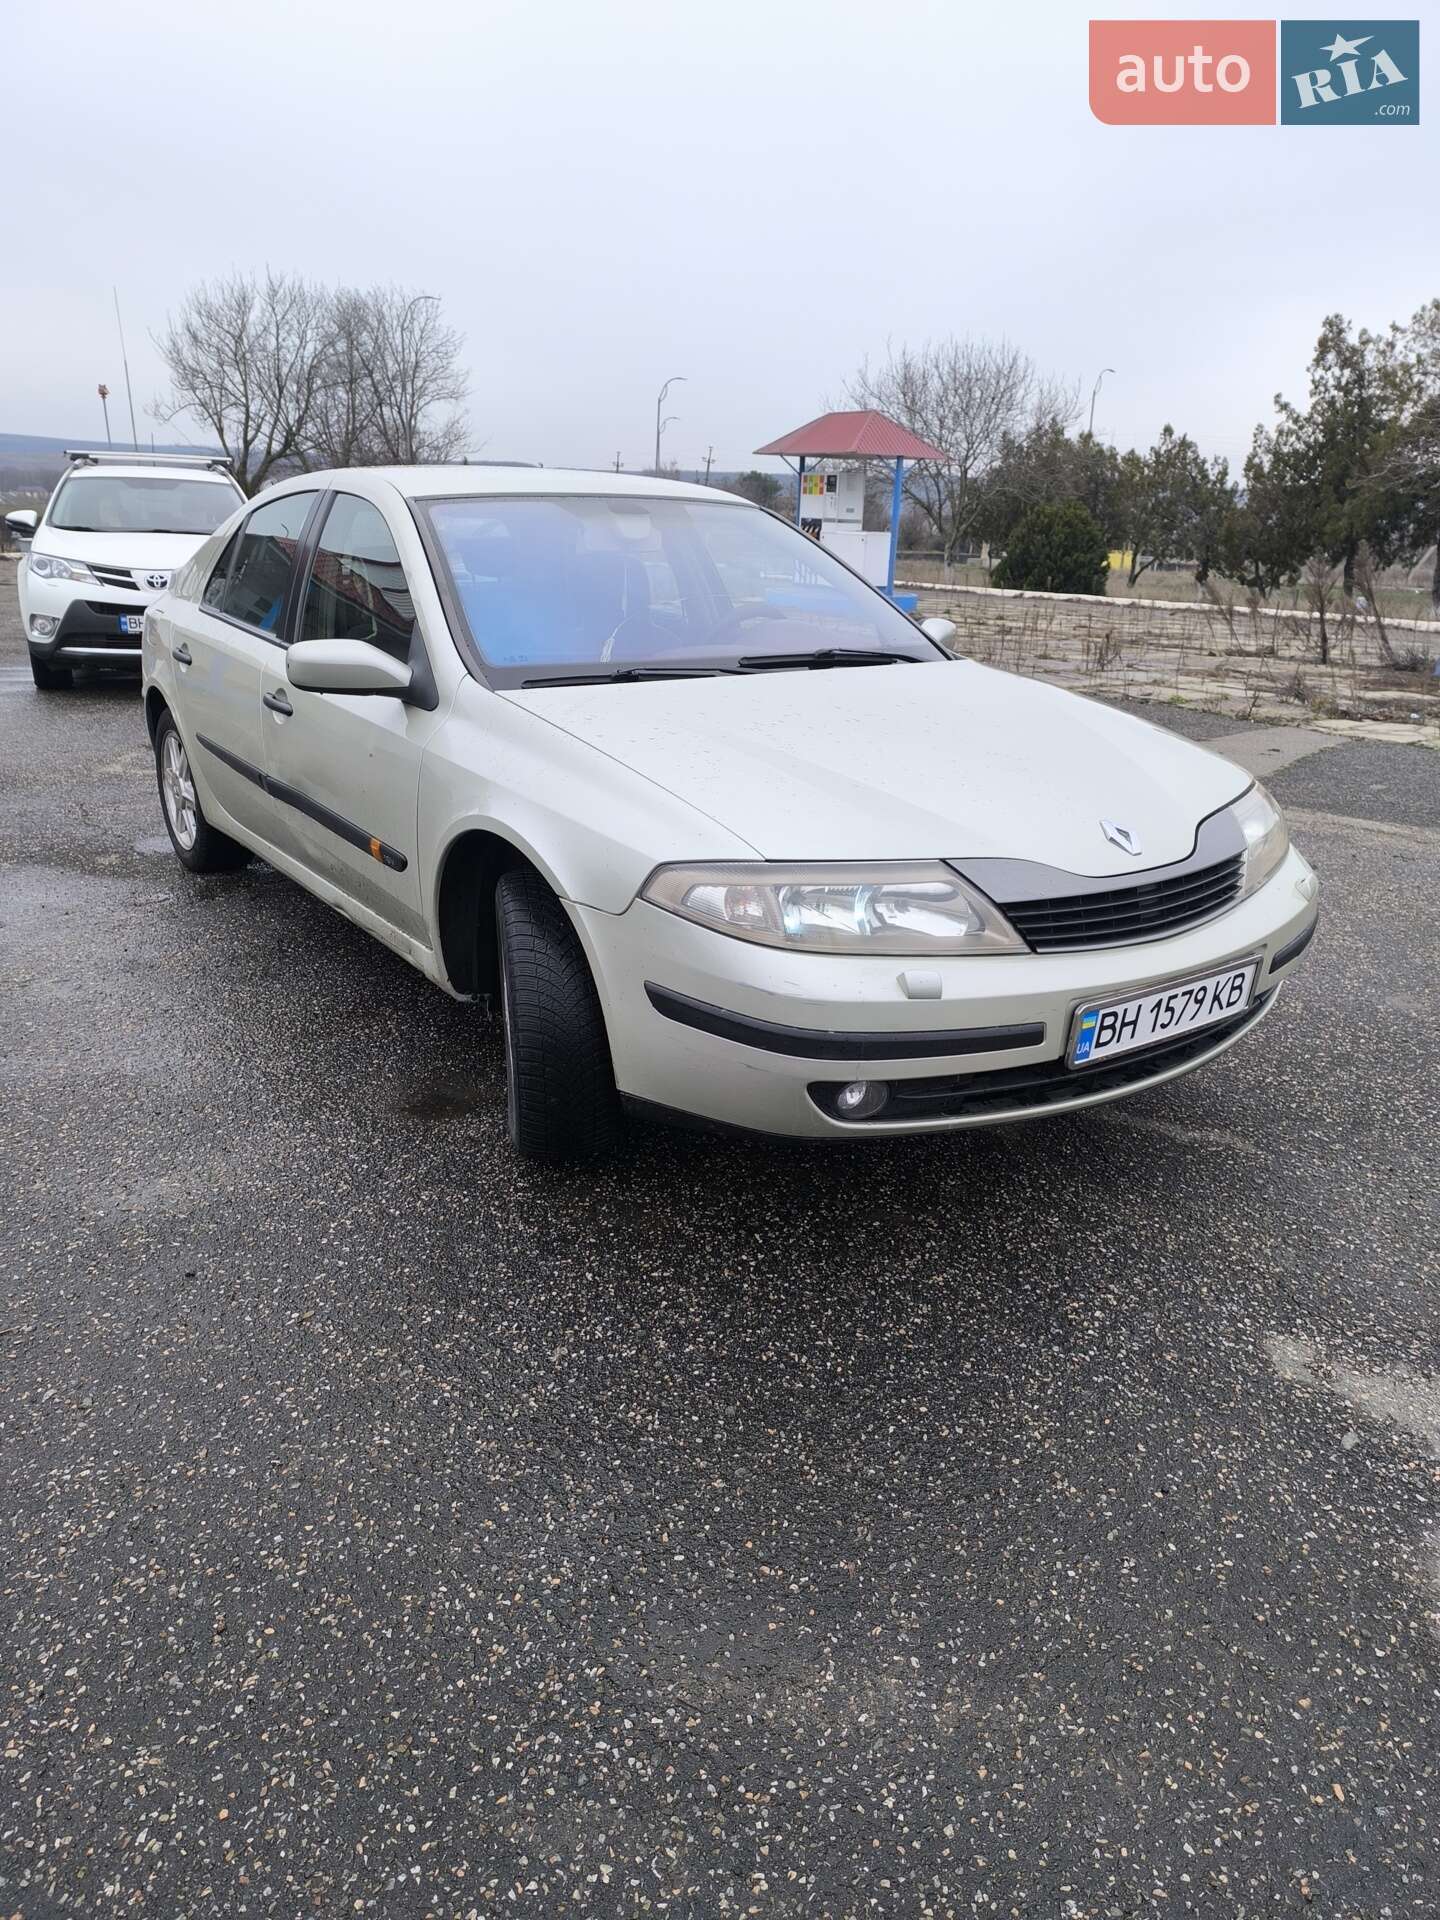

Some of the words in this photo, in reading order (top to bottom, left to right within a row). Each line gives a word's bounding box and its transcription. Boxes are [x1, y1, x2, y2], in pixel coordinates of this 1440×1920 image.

[1094, 1003, 1142, 1049] BH
[1149, 985, 1208, 1033] 1579
[1208, 972, 1246, 1015] KB
[1076, 1043, 1090, 1055] UA
